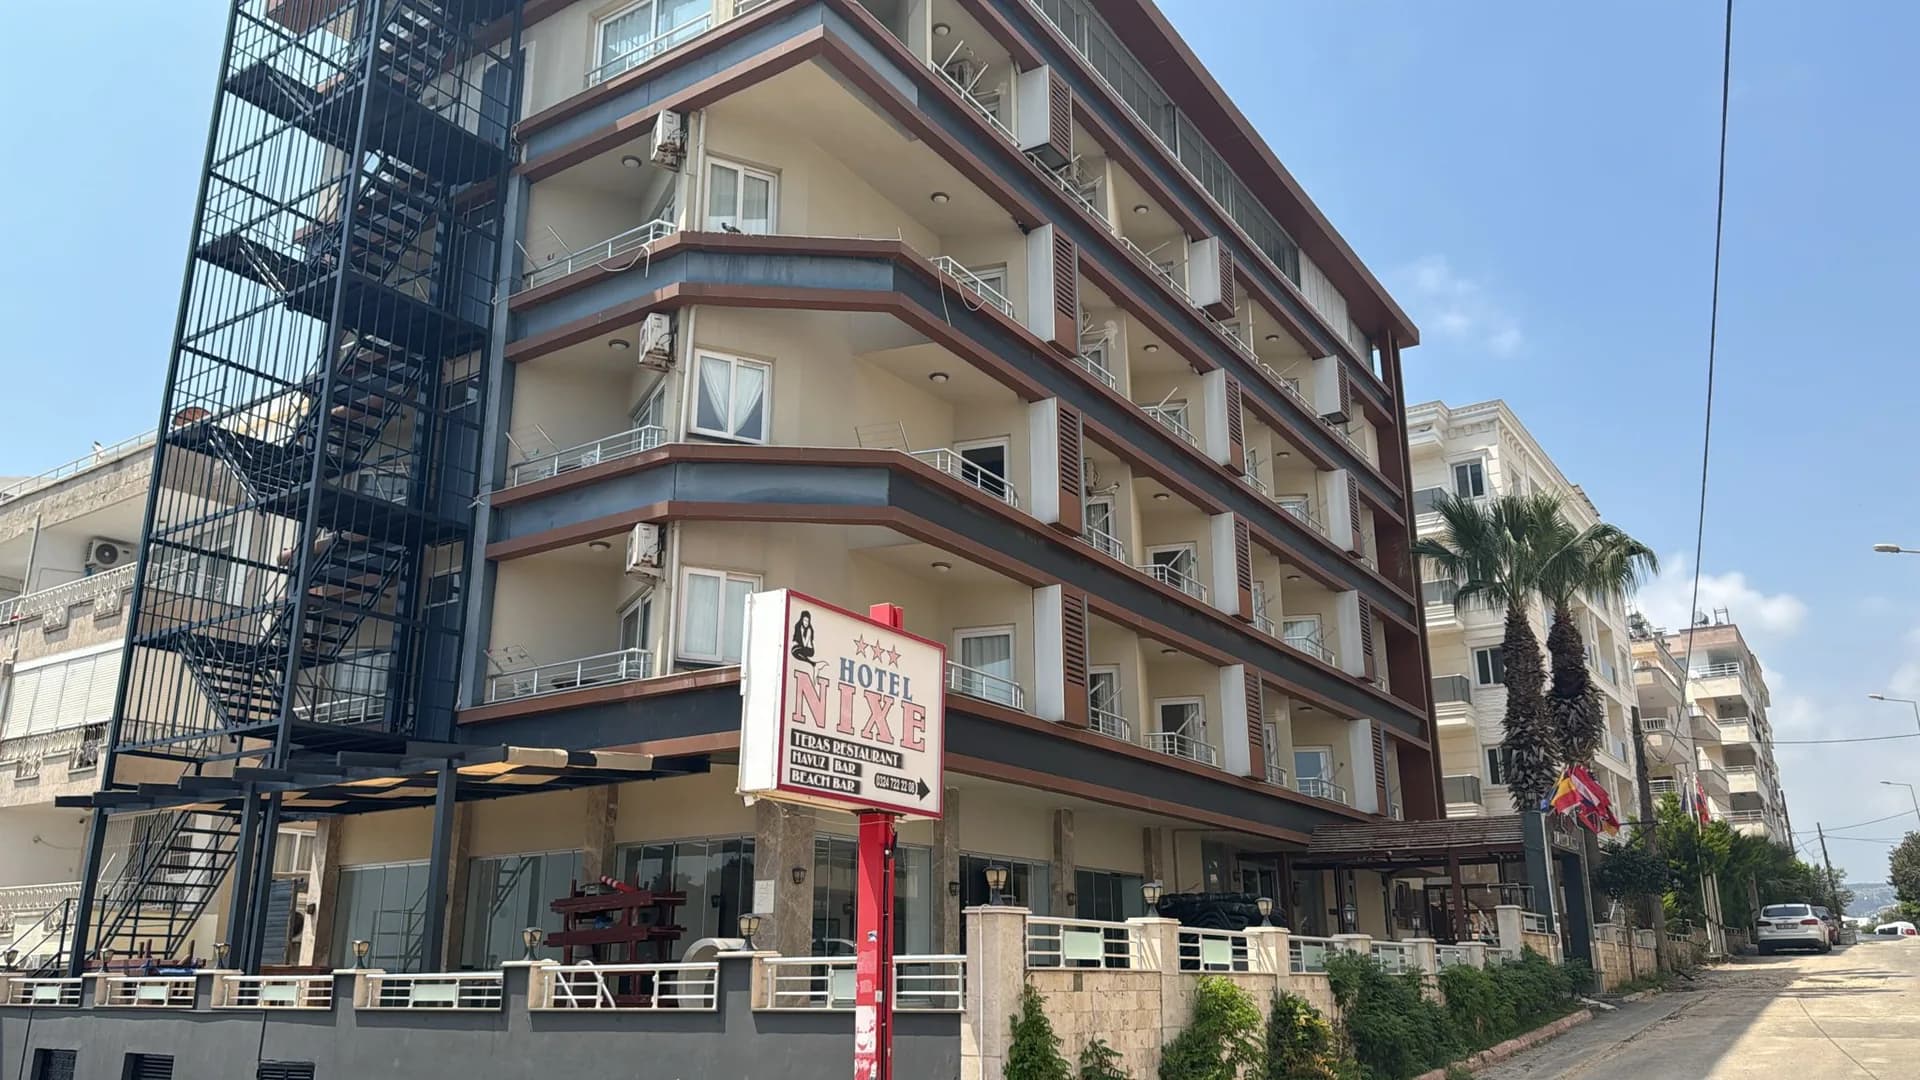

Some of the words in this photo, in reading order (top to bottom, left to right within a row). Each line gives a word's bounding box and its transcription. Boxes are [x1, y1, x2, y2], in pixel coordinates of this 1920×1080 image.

[840, 657, 913, 701] HOTEL
[792, 670, 926, 752] NIXE
[792, 751, 826, 768] HAVUZ
[834, 759, 856, 775] BAR
[793, 732, 831, 752] TERAS
[832, 740, 899, 767] RESTAURANT
[791, 770, 831, 788] BEACH
[832, 779, 855, 792] BAR
[876, 774, 890, 788] 0324
